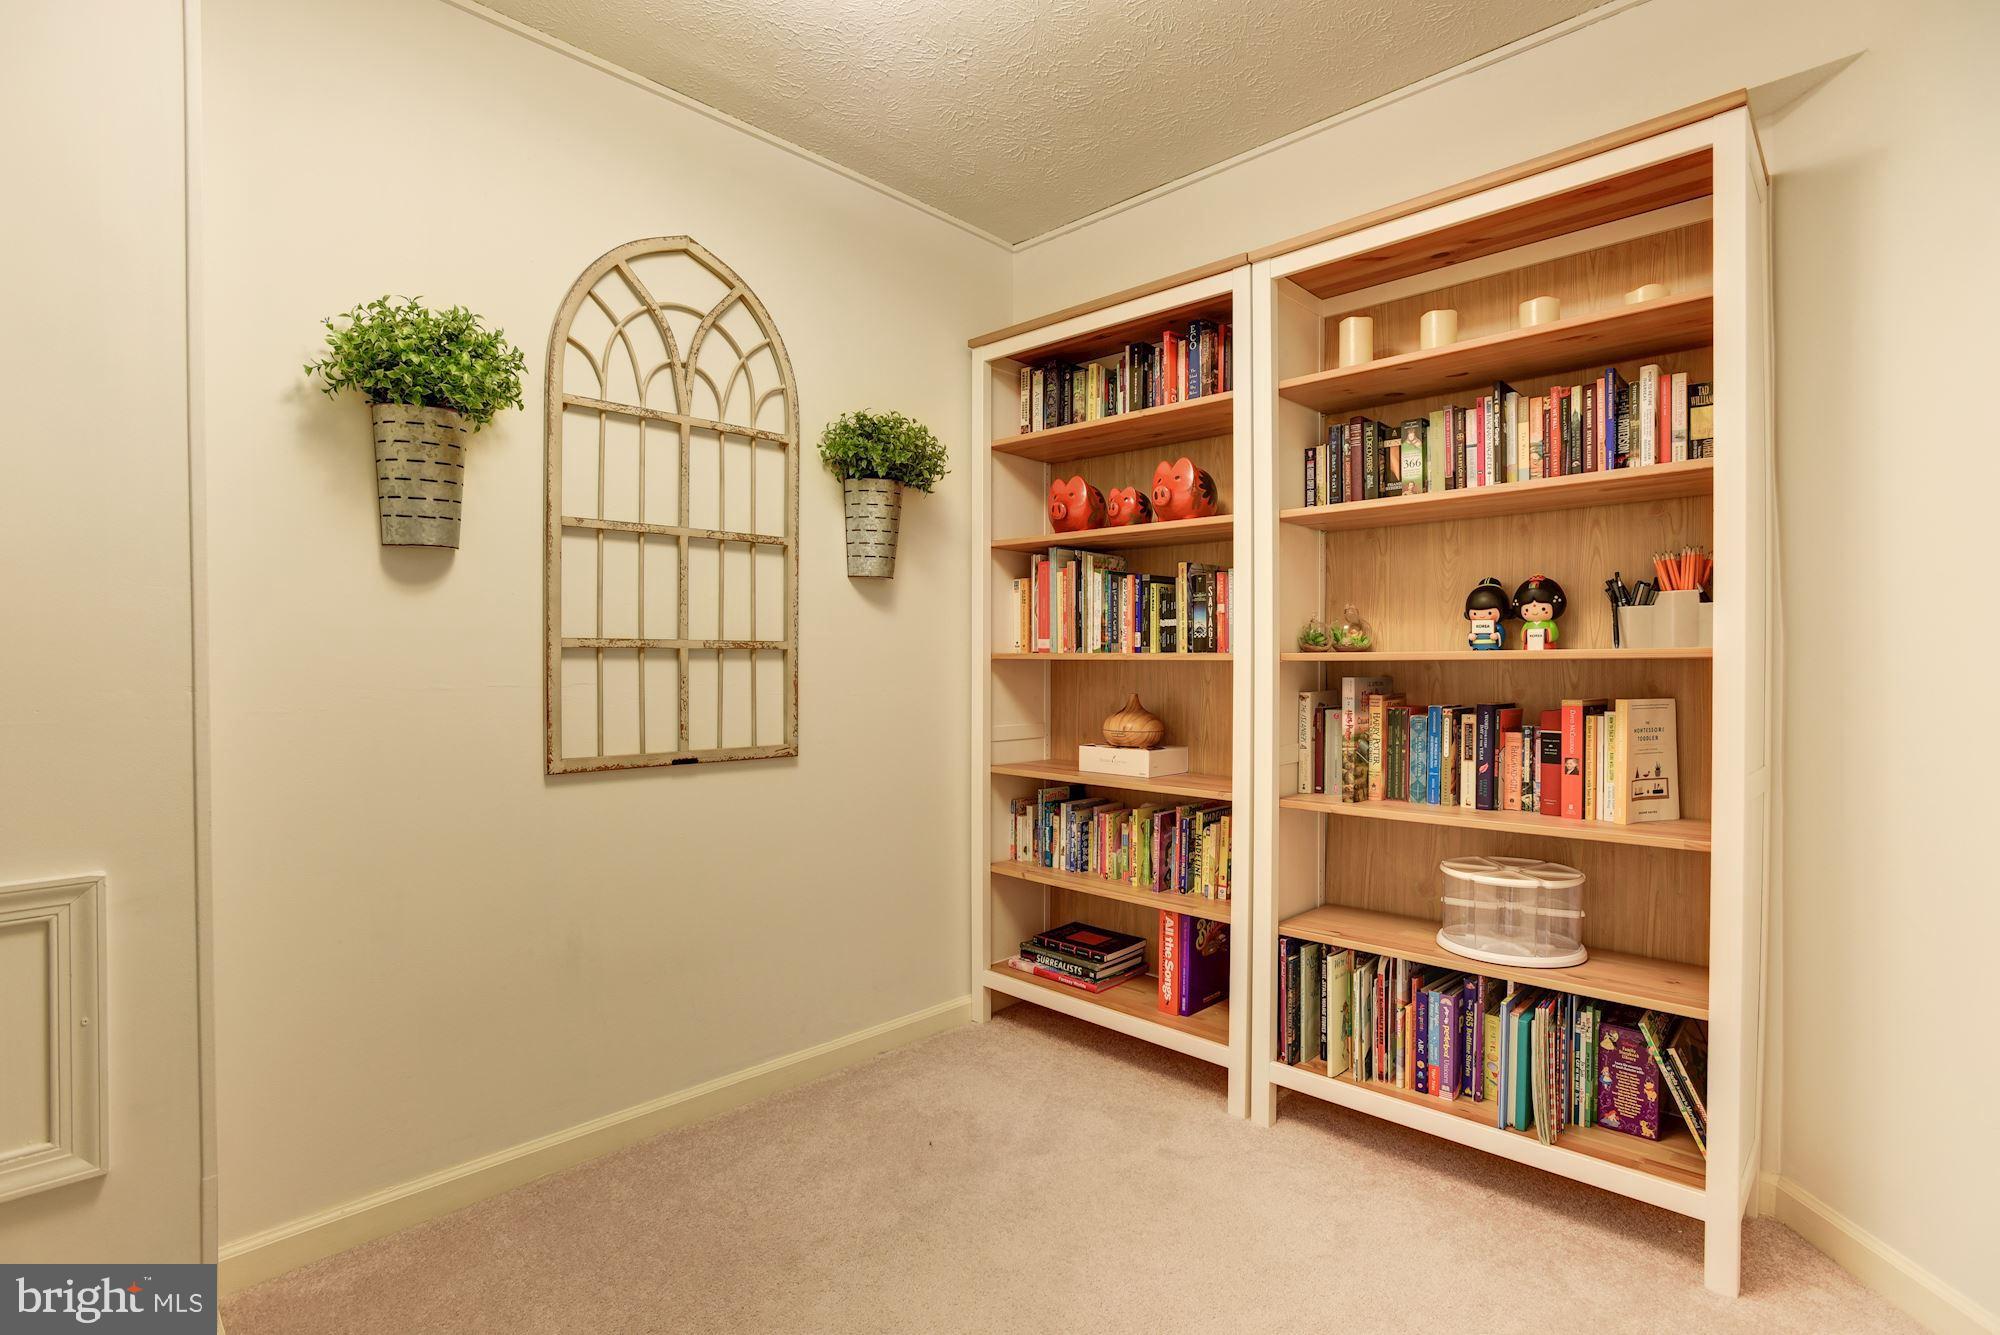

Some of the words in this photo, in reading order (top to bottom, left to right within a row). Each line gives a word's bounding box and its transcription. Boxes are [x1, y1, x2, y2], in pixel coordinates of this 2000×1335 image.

[1189, 324, 1197, 350] ECO
[1618, 418, 1630, 454] PATTERSON
[1403, 458, 1421, 470] 366
[1372, 712, 1380, 736] HARRY
[1372, 738, 1381, 765] POTTER
[1195, 833, 1203, 879] MADELINE
[1164, 916, 1175, 935] All
[1164, 936, 1175, 959] the
[1036, 954, 1083, 976] SURREALISTS
[1161, 960, 1175, 1001] Songs
[1465, 1009, 1474, 1026] 365
[1465, 1027, 1473, 1054] Bedtime
[1465, 1055, 1473, 1077] Stories
